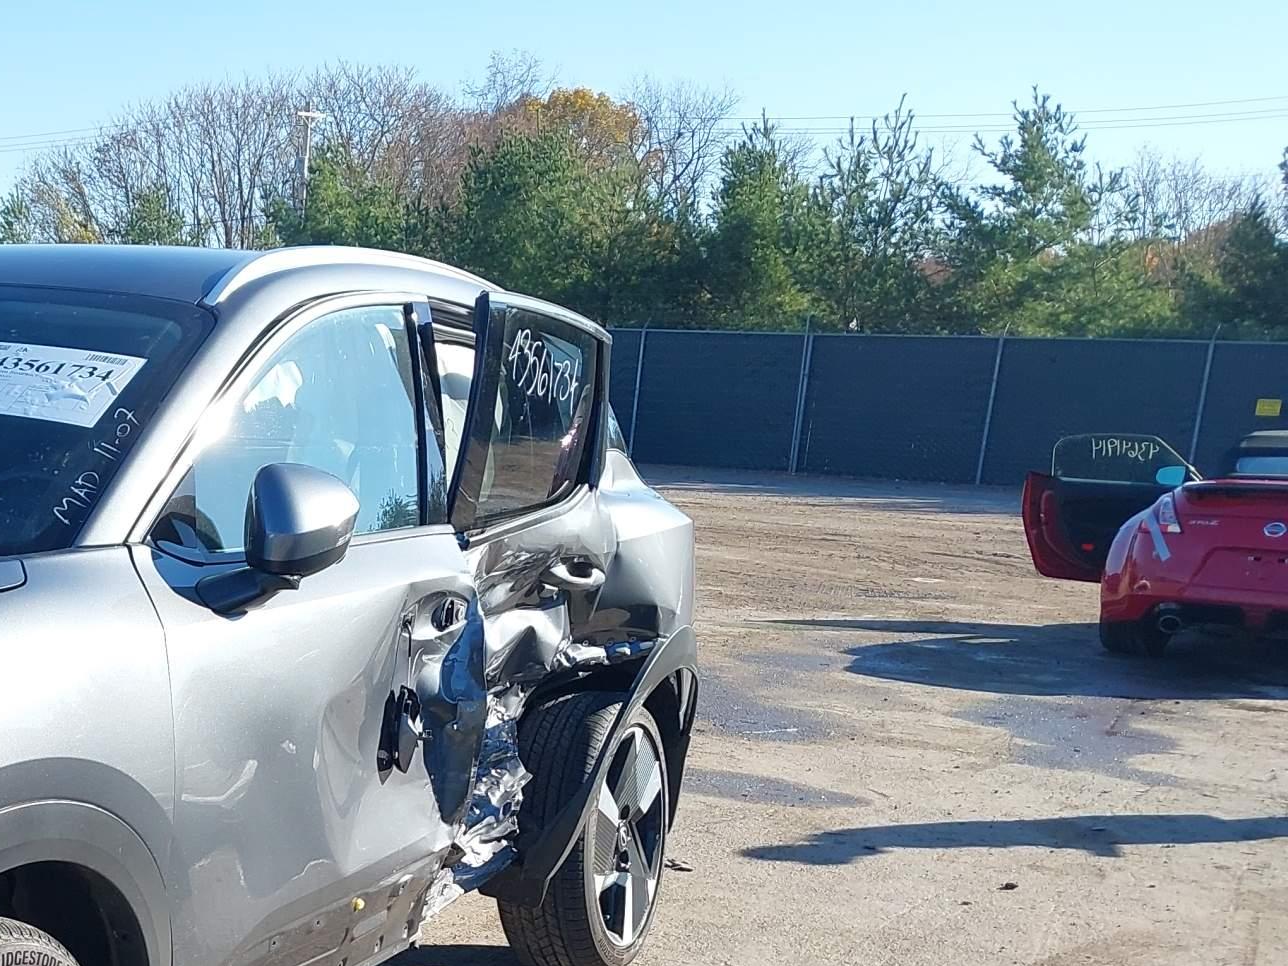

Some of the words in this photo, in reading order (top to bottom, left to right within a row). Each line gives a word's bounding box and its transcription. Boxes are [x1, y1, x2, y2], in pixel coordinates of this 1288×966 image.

[509, 329, 579, 417] 43561734
[53, 471, 100, 525] MAD
[93, 408, 140, 460] 11-07
